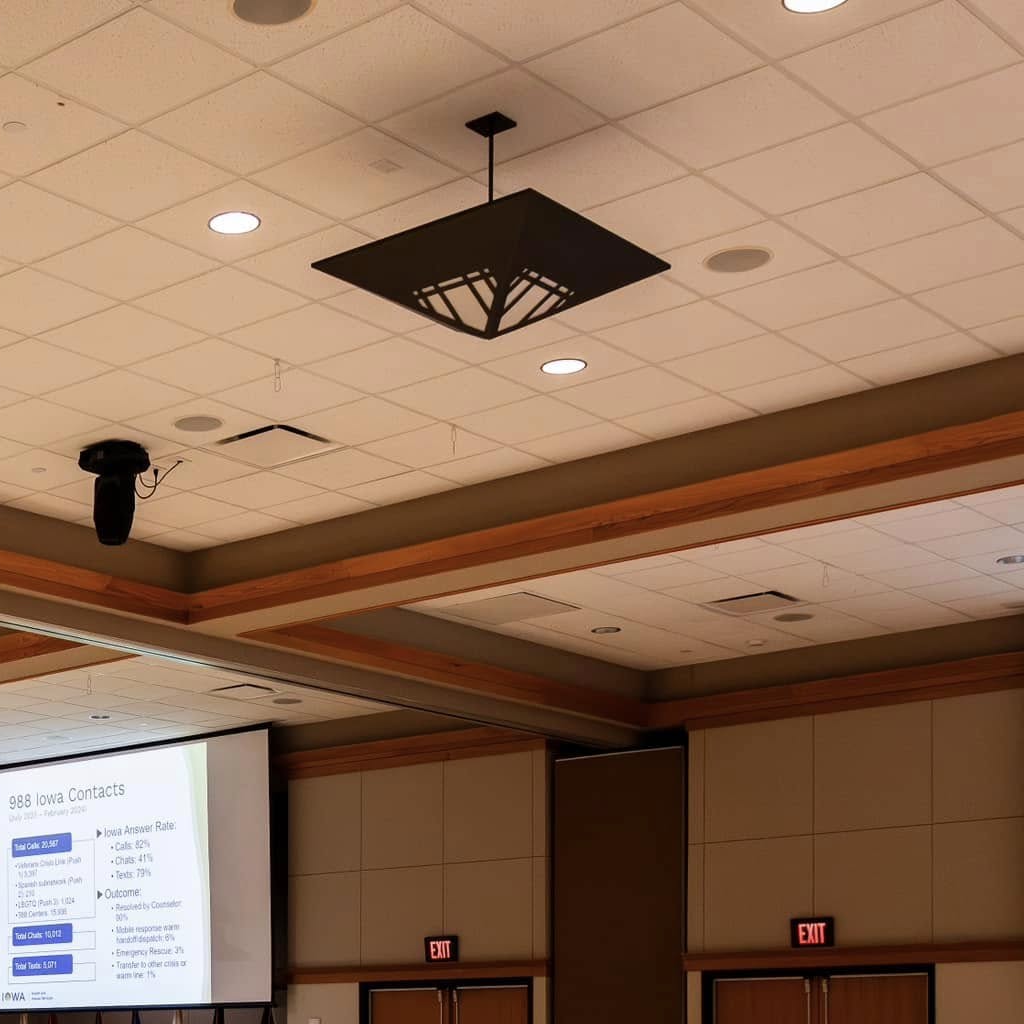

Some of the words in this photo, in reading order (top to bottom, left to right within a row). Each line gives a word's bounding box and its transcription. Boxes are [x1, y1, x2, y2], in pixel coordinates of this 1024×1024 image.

[9, 794, 32, 810] 988
[36, 792, 64, 807] Iowa
[69, 782, 125, 802] Contacts
[104, 827, 122, 838] Iowa
[124, 825, 153, 835] Answer
[156, 820, 176, 832] Rate:
[135, 839, 150, 849] 82%
[115, 855, 136, 865] Chats:
[138, 853, 153, 863] 41%
[116, 870, 135, 880] Texts:
[137, 867, 151, 878] 79%
[105, 888, 142, 899] Outcome:
[15, 932, 27, 940] Total
[797, 922, 826, 944] EXIT
[116, 948, 148, 958] Emergency
[429, 940, 451, 959] EXIT
[15, 962, 27, 970] Total
[148, 960, 163, 968] other
